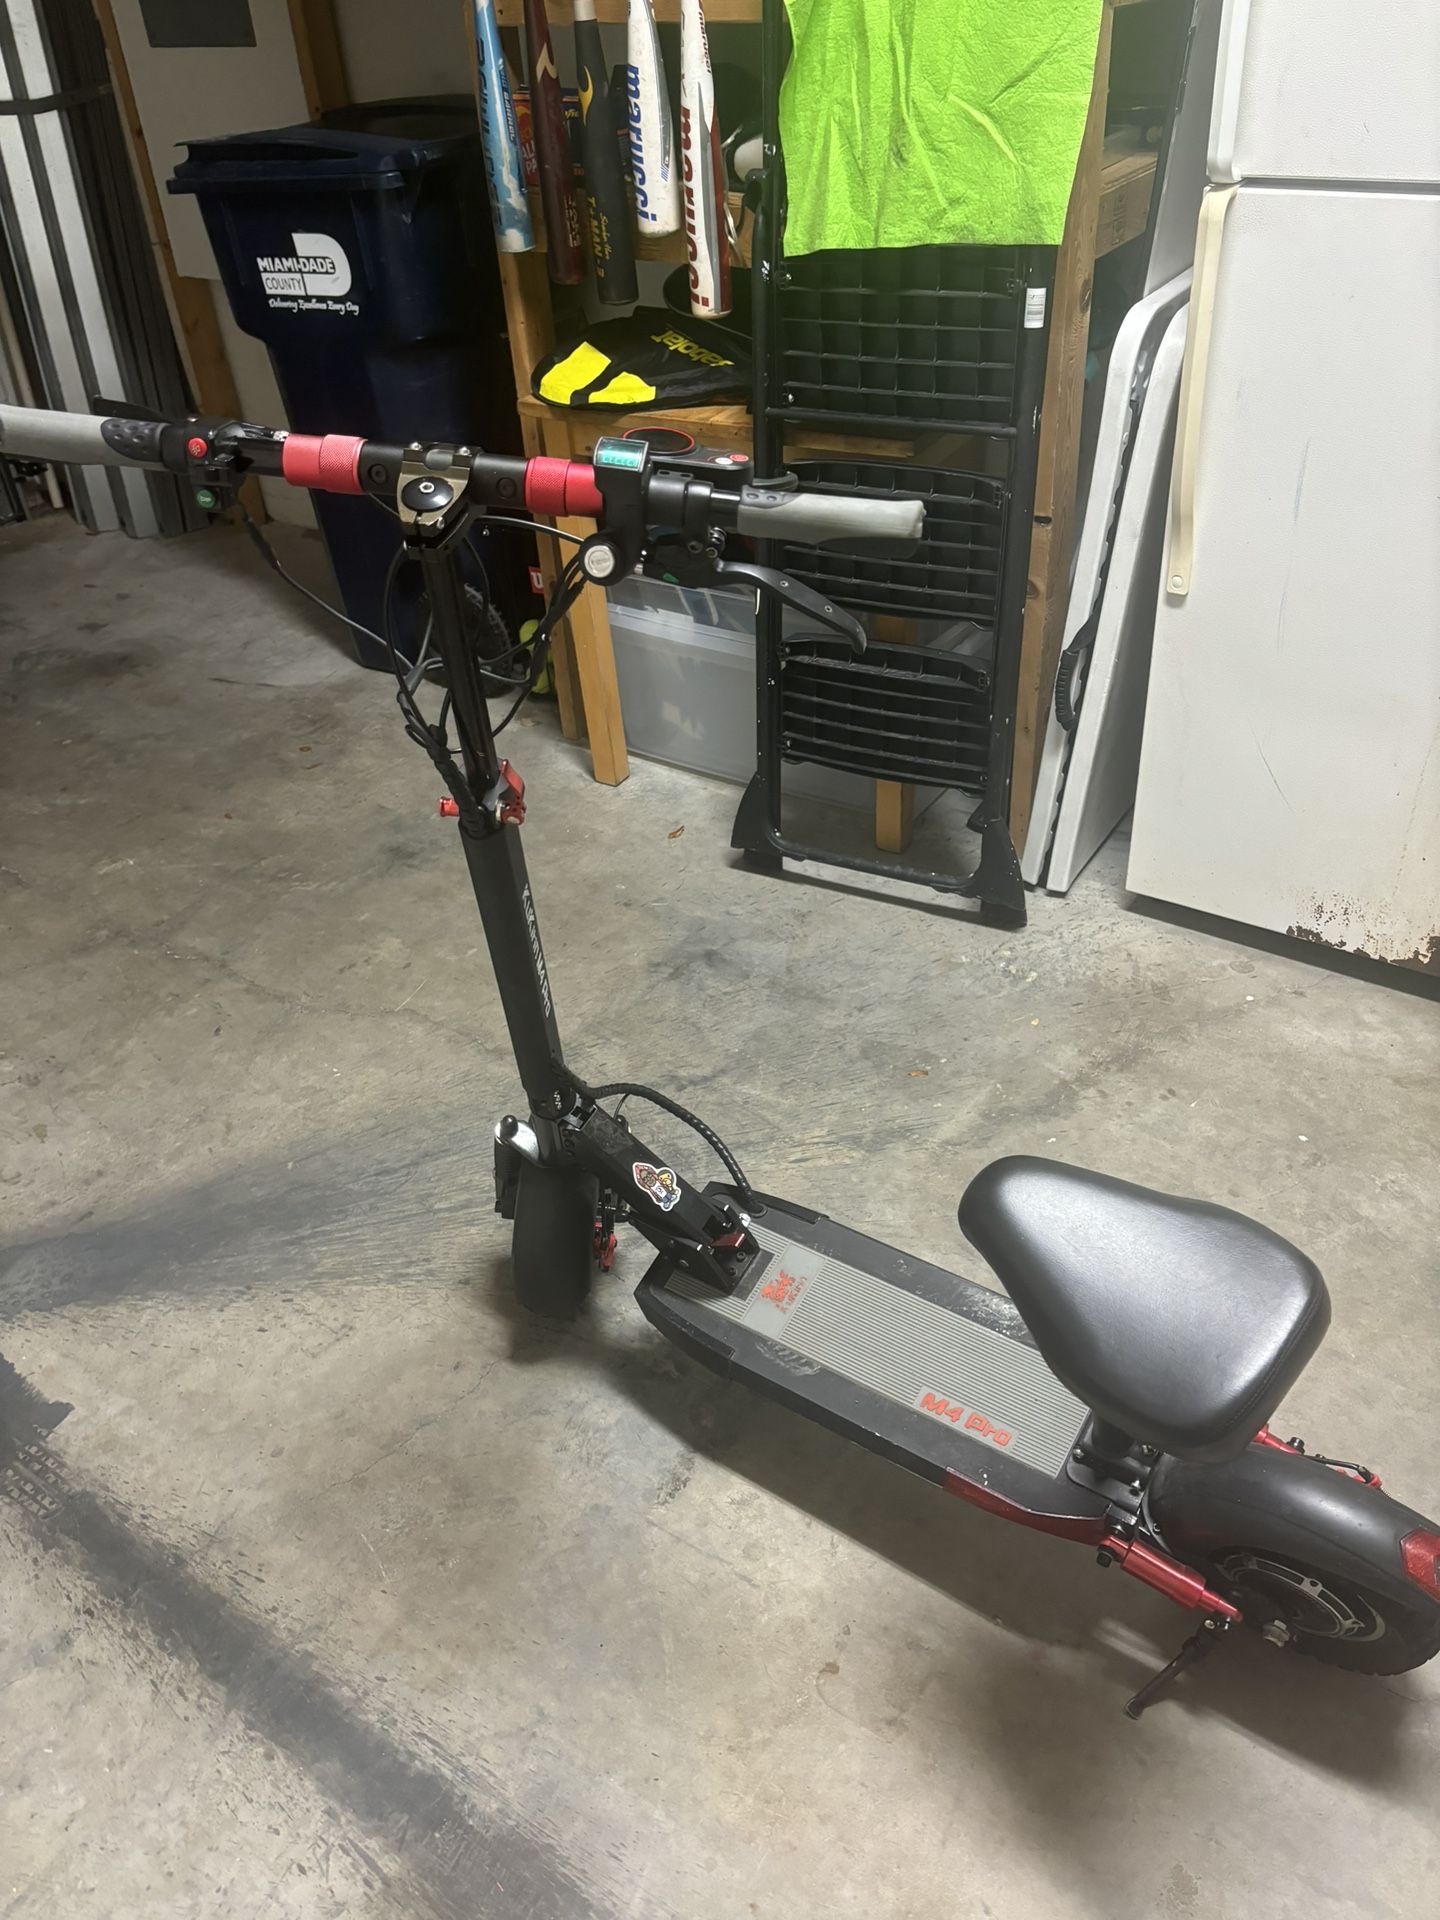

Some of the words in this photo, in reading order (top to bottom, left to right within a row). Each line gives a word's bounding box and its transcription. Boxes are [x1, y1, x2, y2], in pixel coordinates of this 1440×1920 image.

[626, 64, 657, 222] marucci
[256, 256, 335, 273] MIAMI-DADE
[265, 277, 303, 291] COUNTY
[919, 1392, 964, 1422] M4
[963, 1412, 1012, 1446] Pro
